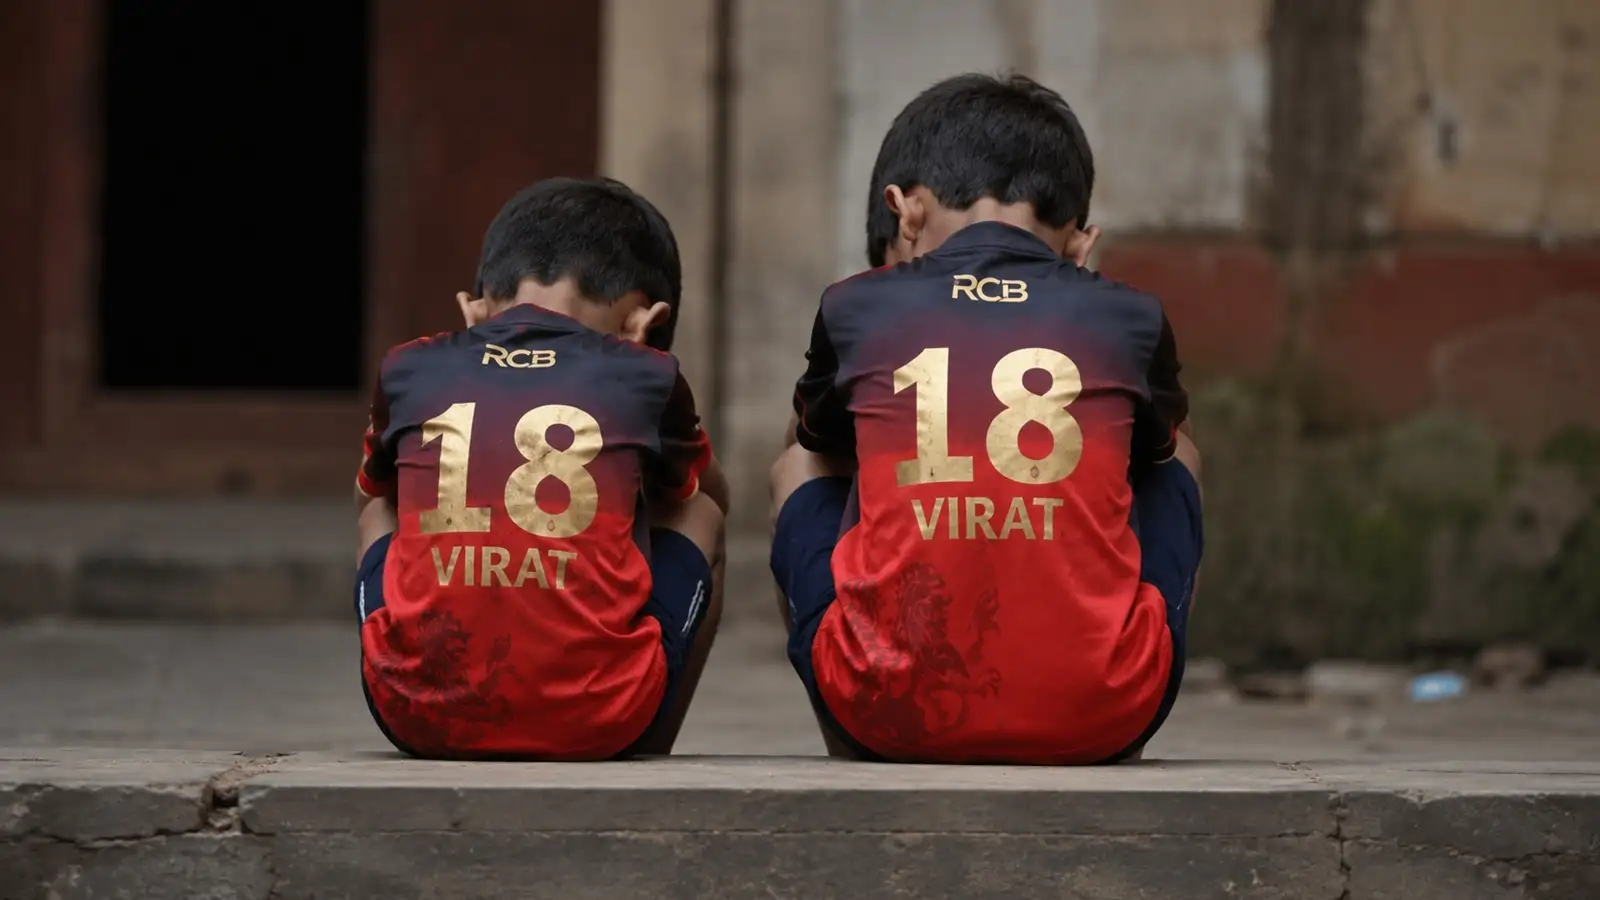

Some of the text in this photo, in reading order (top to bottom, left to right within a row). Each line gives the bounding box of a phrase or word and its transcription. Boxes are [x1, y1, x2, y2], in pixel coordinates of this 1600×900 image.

[952, 274, 1028, 302] RCB
[481, 343, 557, 368] RCB
[893, 347, 1083, 487] 18
[419, 402, 603, 538] 18
[911, 496, 1064, 540] VIRAT
[430, 545, 578, 590] VIRAT
